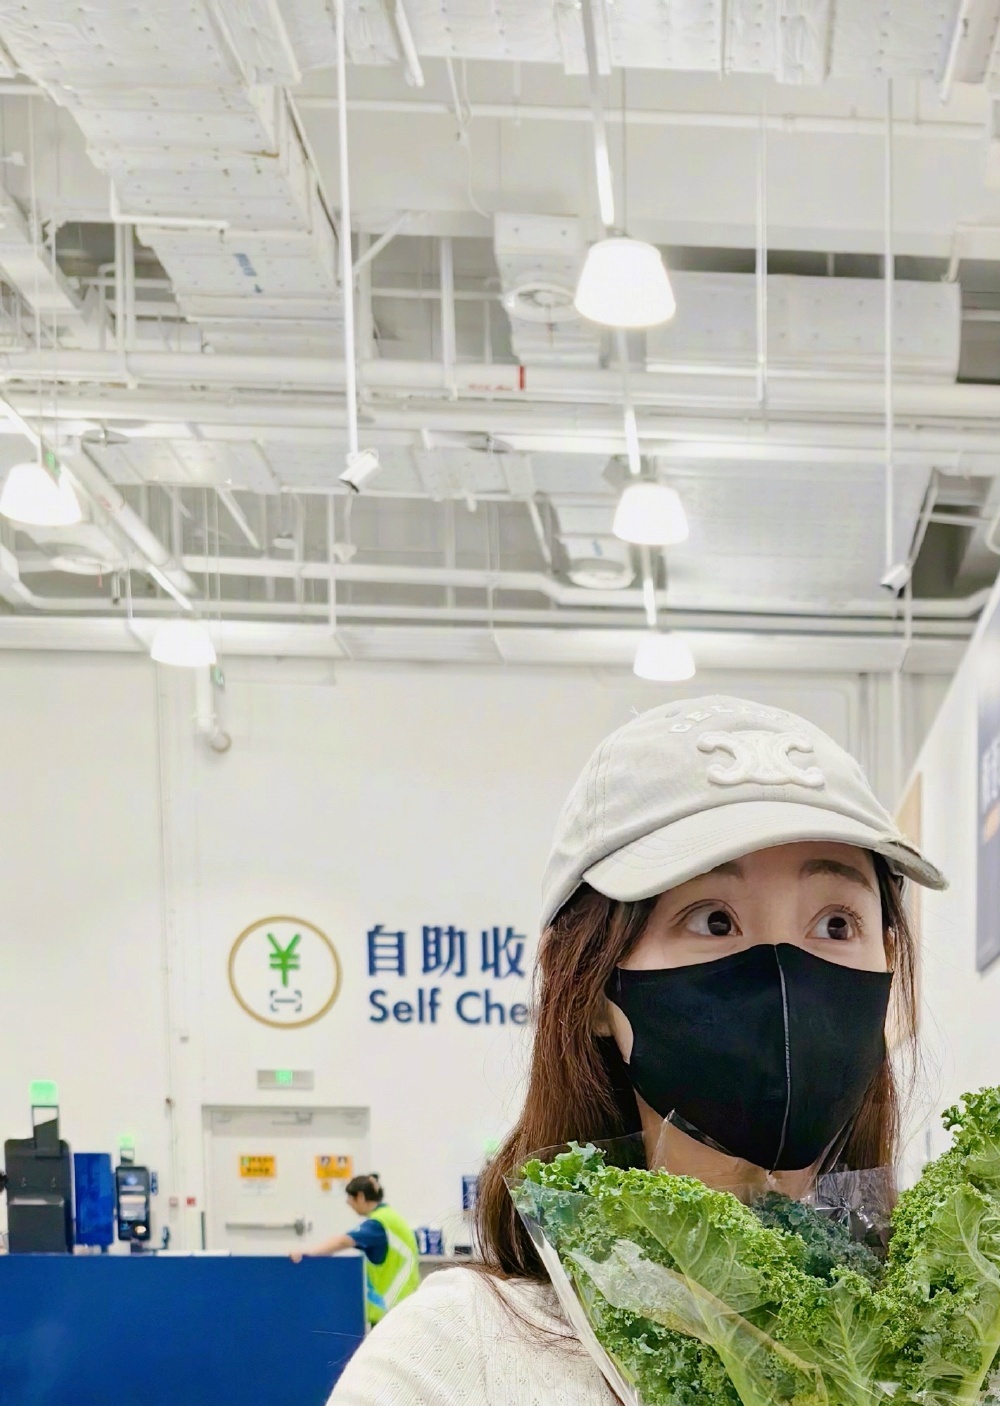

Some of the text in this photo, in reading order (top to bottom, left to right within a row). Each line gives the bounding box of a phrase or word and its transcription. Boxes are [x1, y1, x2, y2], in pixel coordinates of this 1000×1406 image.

[366, 924, 527, 978] 自助收
[369, 986, 529, 1025] Self Che
